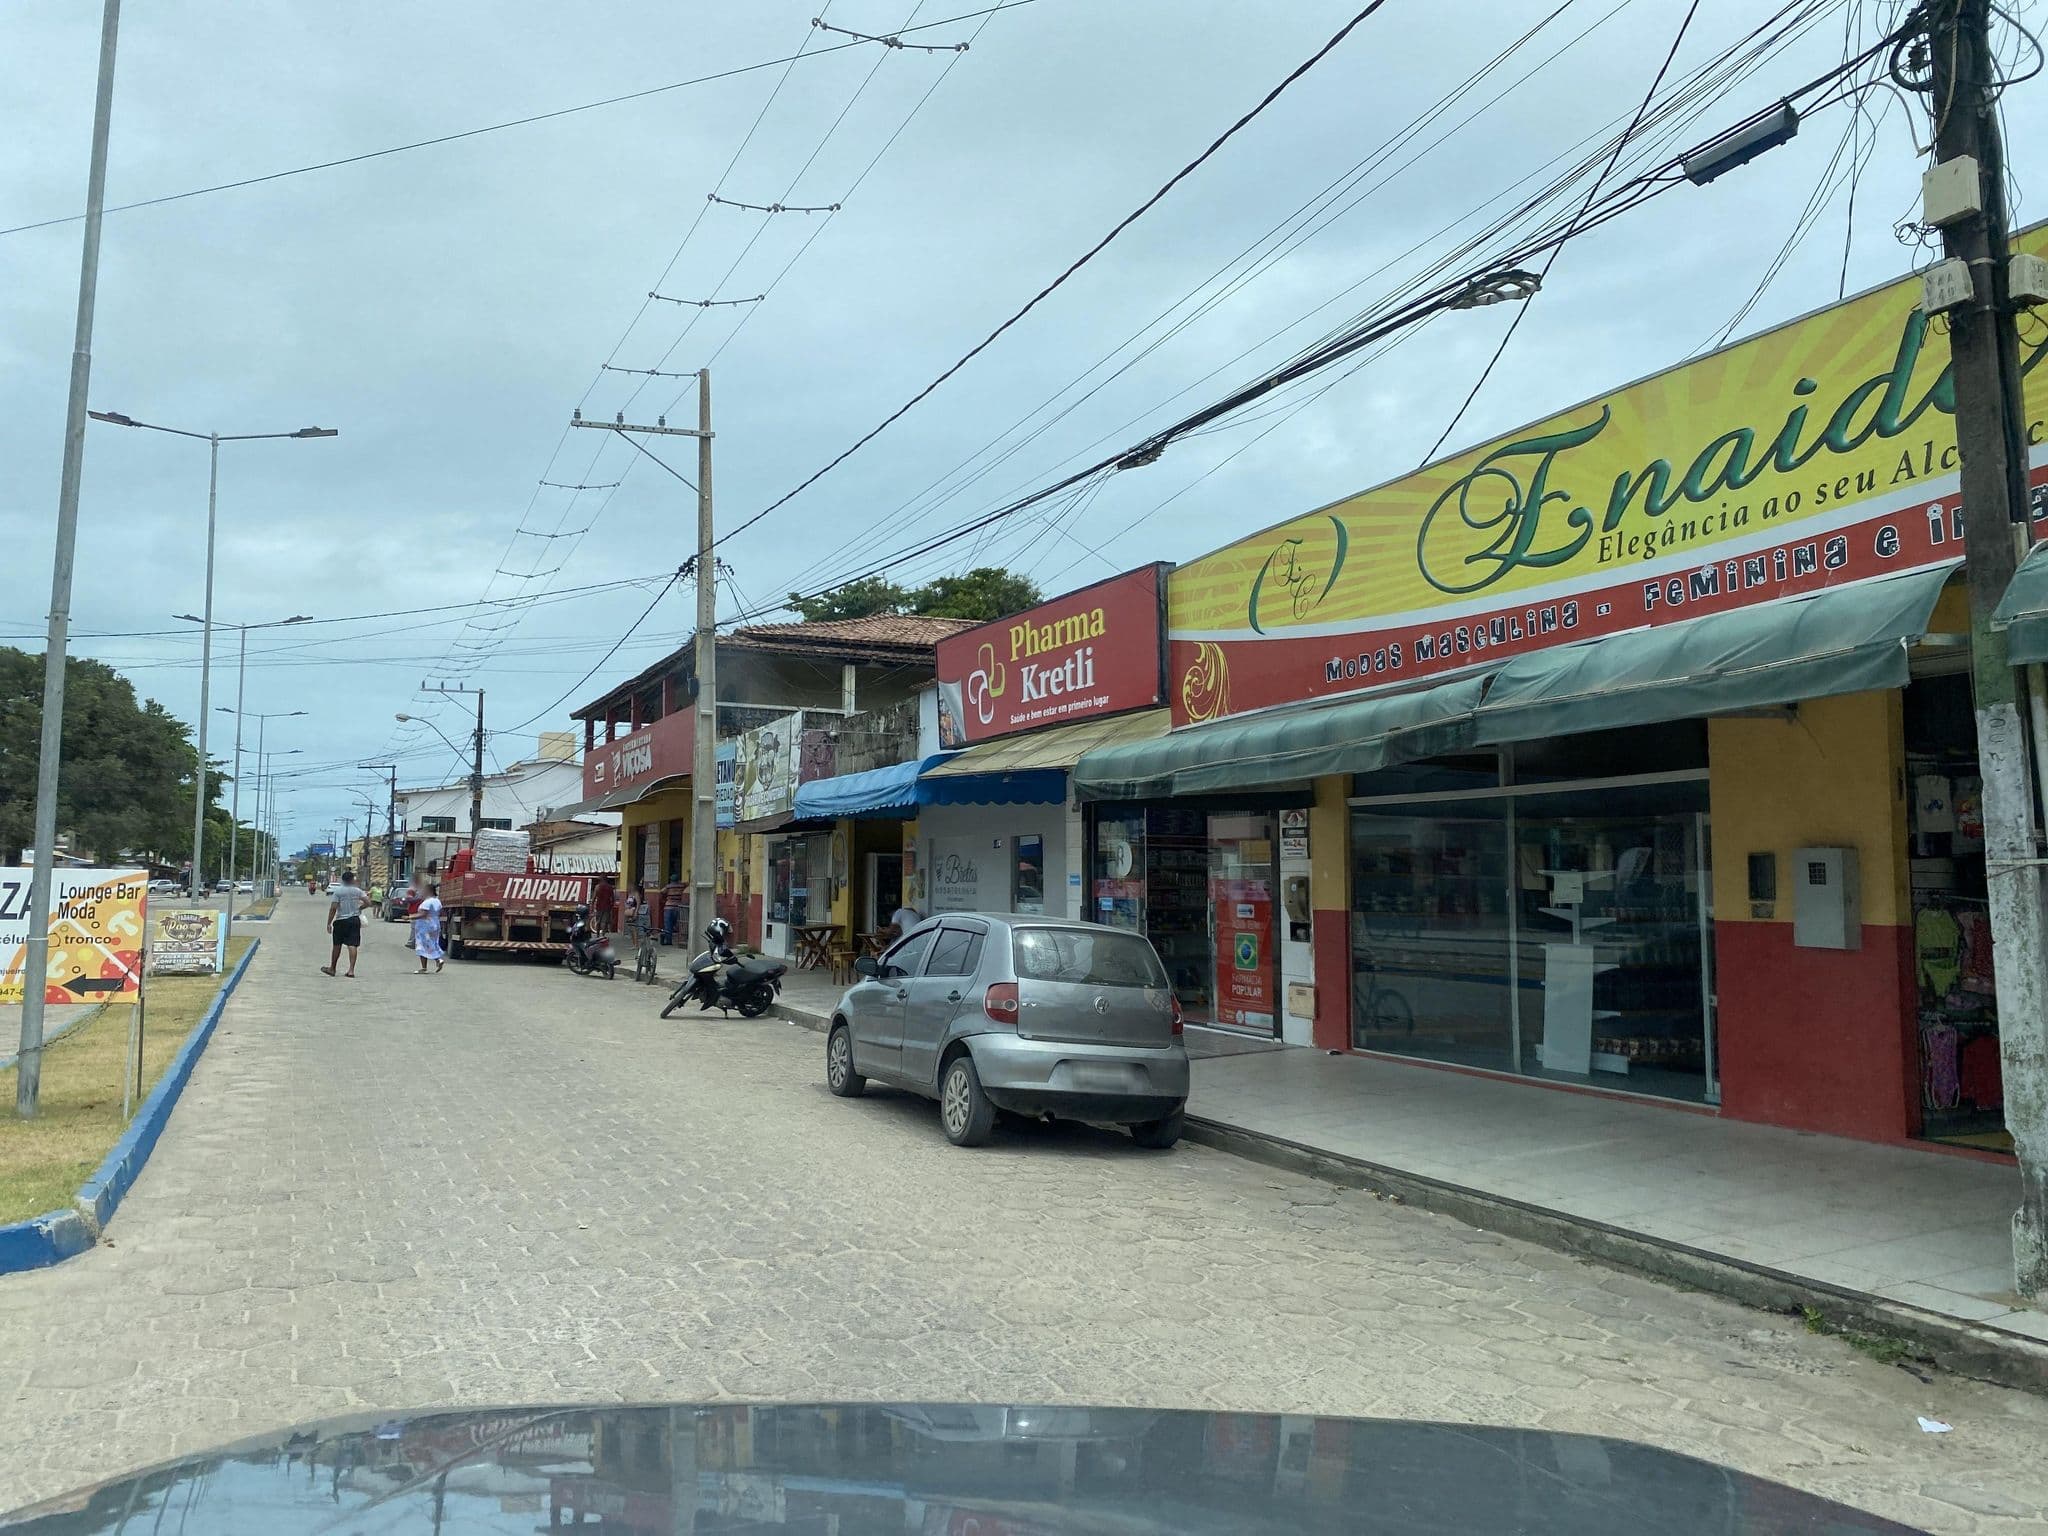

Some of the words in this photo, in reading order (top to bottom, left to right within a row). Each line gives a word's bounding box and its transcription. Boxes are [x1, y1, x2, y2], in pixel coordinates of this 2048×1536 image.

[1597, 502, 1750, 564] Elegância
[1763, 490, 1801, 520] ao
[1815, 468, 1876, 505] seu
[1874, 524, 1901, 558] e
[1009, 607, 1106, 662] Pharma
[1020, 646, 1095, 703] Kretli
[1010, 714, 1026, 725] Saúde
[1026, 713, 1030, 721] e
[1031, 709, 1042, 720] bem
[1043, 706, 1057, 717] estar
[1058, 704, 1067, 714] em
[1068, 698, 1092, 714] primeiro
[1093, 695, 1109, 708] lugar
[60, 882, 112, 904] Lounge
[116, 882, 141, 900] Bar
[502, 877, 582, 903] ITAIPAVA
[58, 902, 96, 919] Moda
[64, 934, 112, 945] tronco
[1231, 984, 1263, 998] POPULAR
